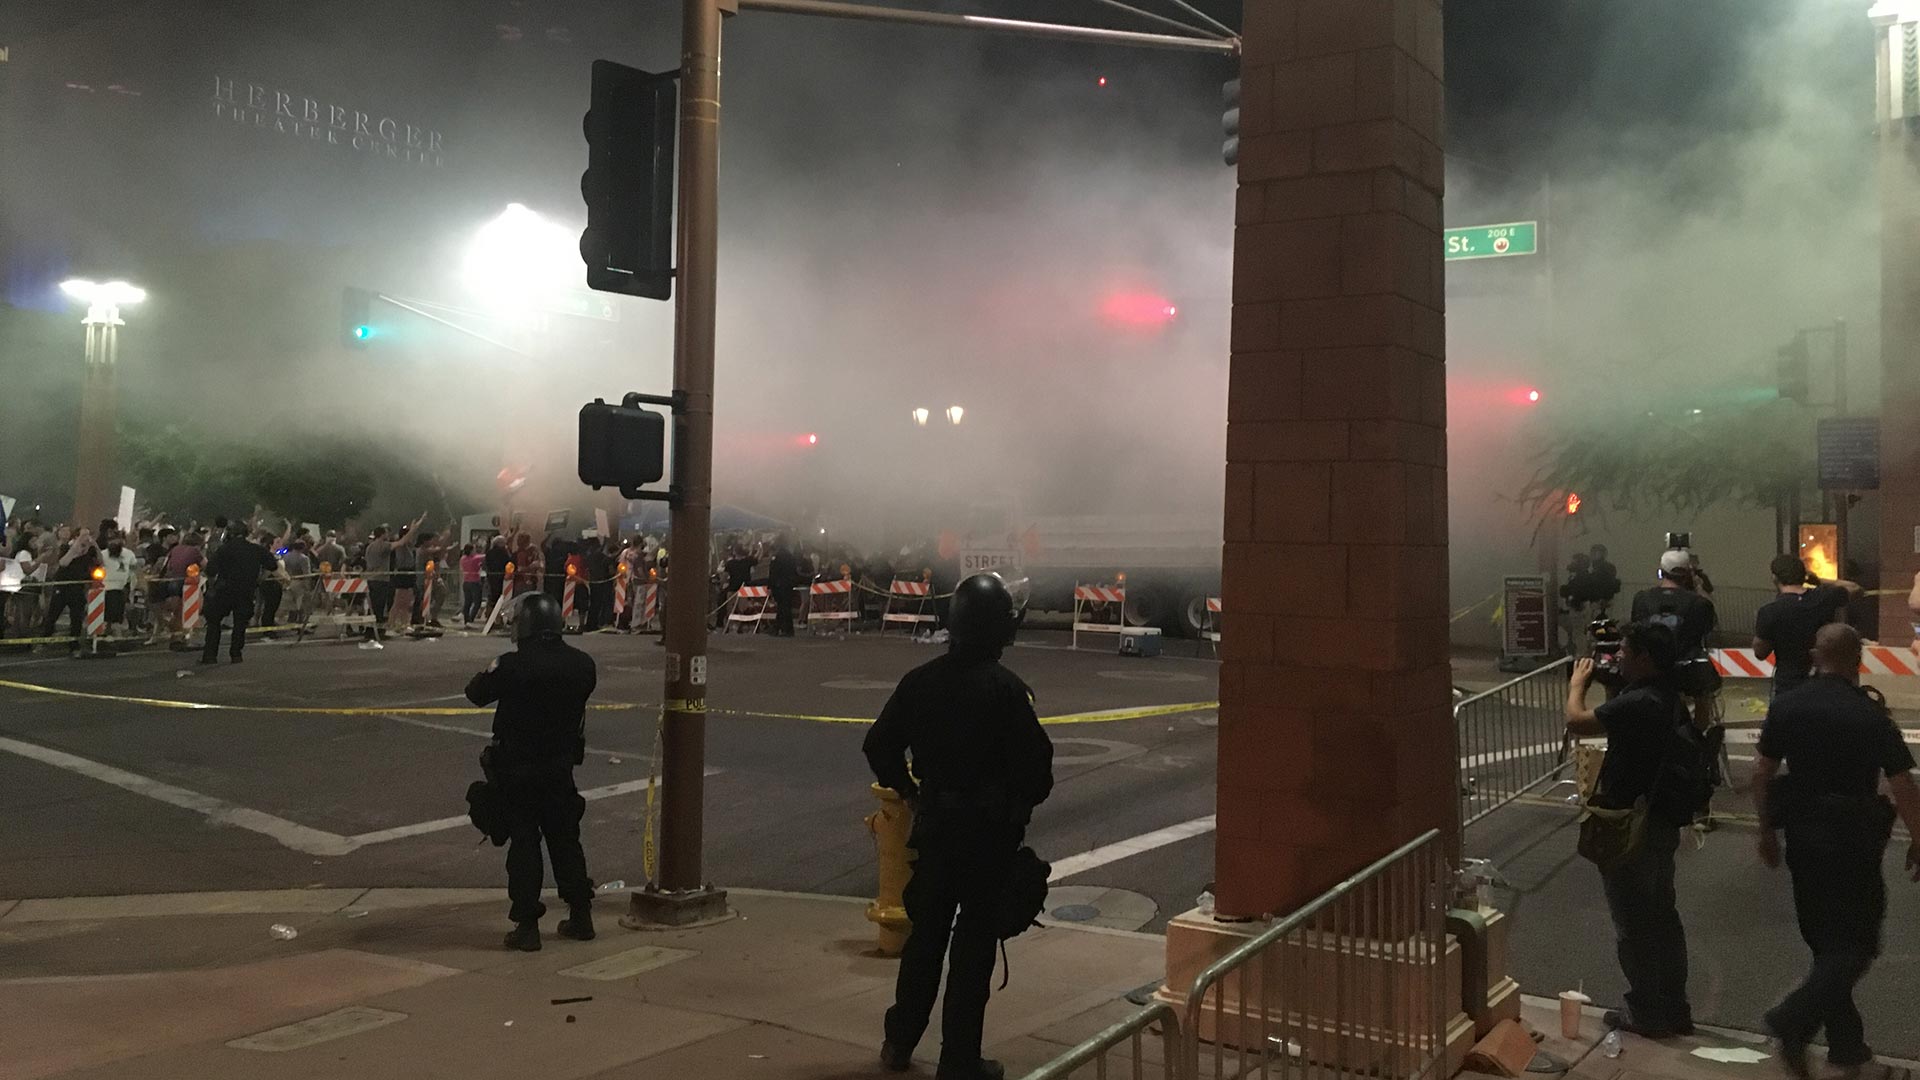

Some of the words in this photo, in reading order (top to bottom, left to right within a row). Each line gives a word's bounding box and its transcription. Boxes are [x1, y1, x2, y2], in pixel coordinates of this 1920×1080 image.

[215, 75, 443, 152] HERBERGER
[213, 101, 338, 145] THEATER
[1487, 228, 1507, 239] 200
[1509, 227, 1516, 237] E
[1448, 236, 1476, 253] St.
[965, 555, 1016, 569] STREET
